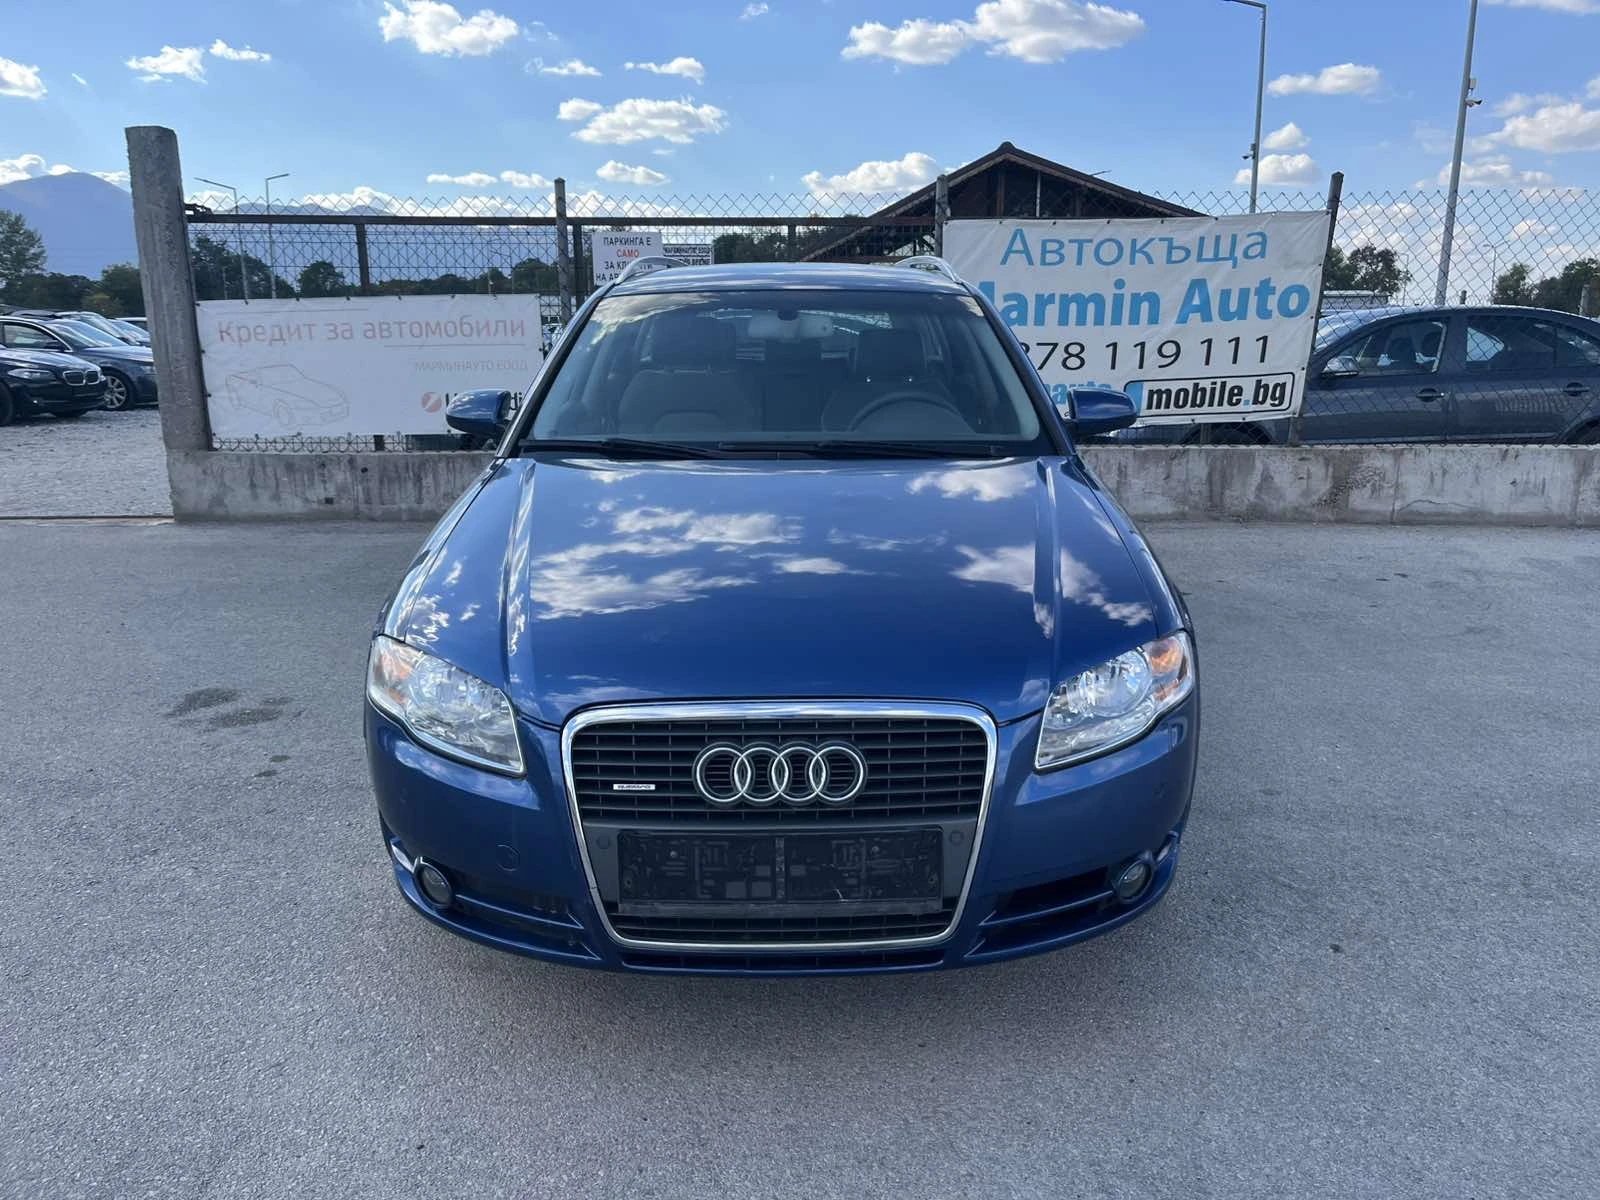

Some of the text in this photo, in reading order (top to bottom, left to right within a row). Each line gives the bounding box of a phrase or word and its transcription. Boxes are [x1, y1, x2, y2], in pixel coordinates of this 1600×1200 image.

[603, 236, 652, 246] ПАРКИНГА Е
[616, 249, 640, 258] САМО
[1000, 227, 1268, 269] Автокъща
[604, 261, 615, 270] ЗА
[1176, 277, 1311, 326] Auto
[218, 314, 526, 346] Кредит за автомобили
[1105, 339, 1182, 371] 119
[1200, 335, 1270, 367] 111
[1145, 377, 1288, 411] mobile.bg
